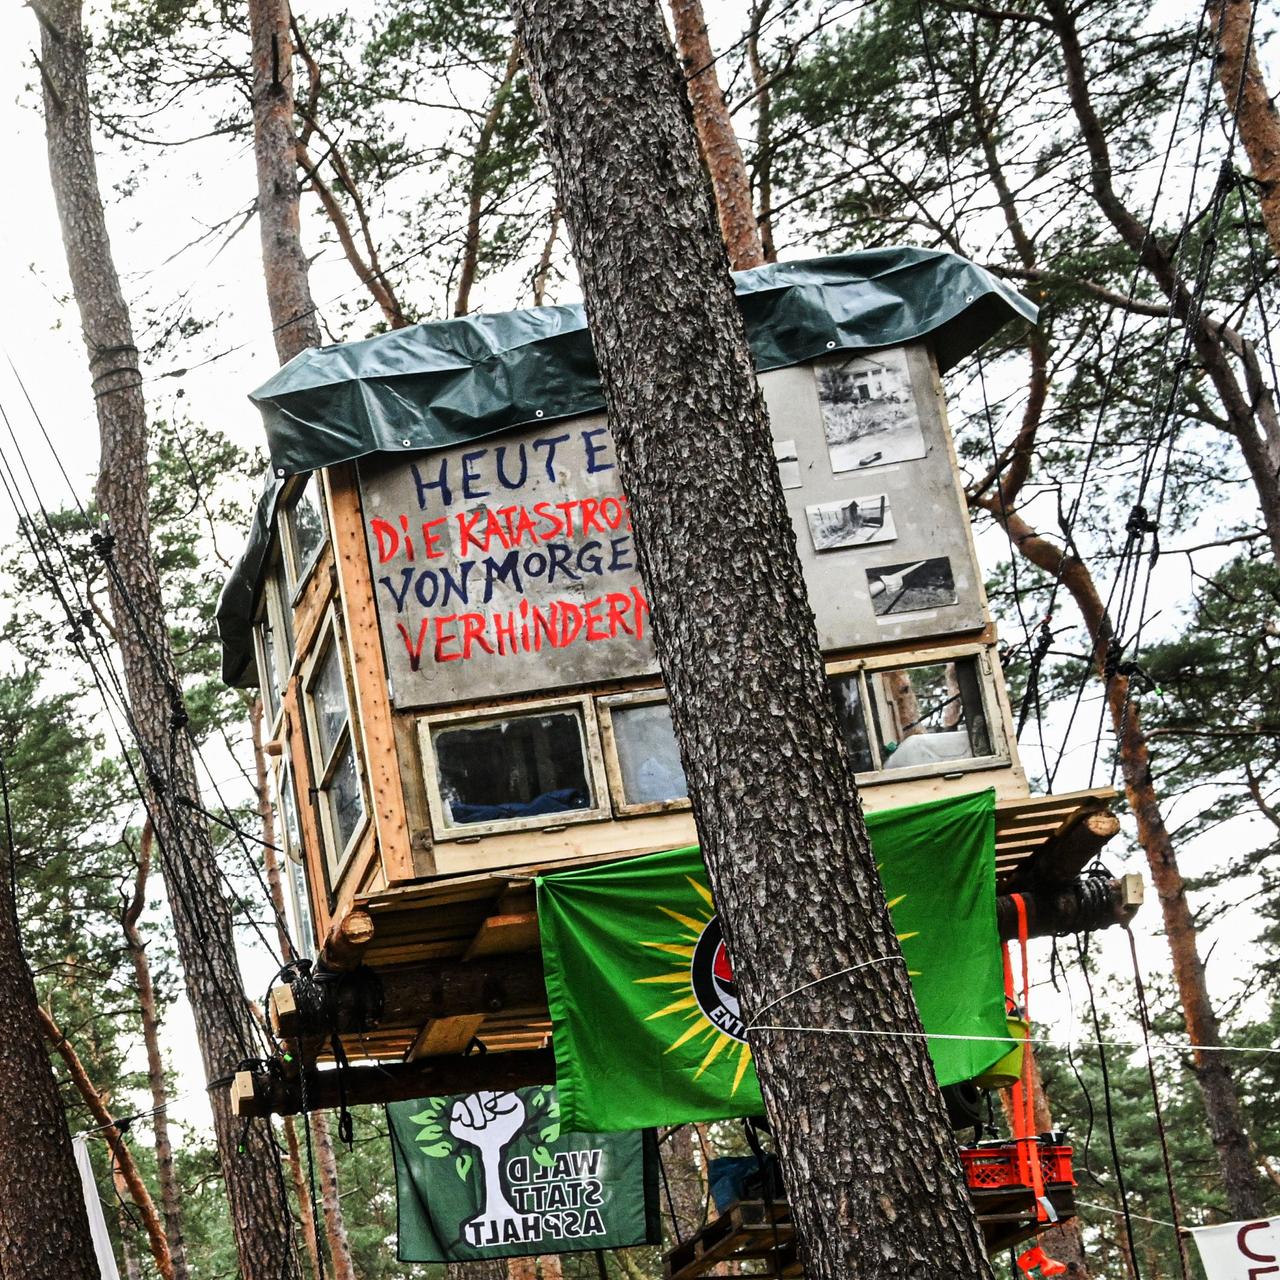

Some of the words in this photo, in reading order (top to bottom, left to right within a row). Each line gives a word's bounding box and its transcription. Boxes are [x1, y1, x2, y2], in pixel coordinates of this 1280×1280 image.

[411, 428, 615, 510] HEUTE
[455, 495, 633, 557] KATASTRO
[379, 560, 476, 613] VON
[483, 536, 640, 604] MORGE
